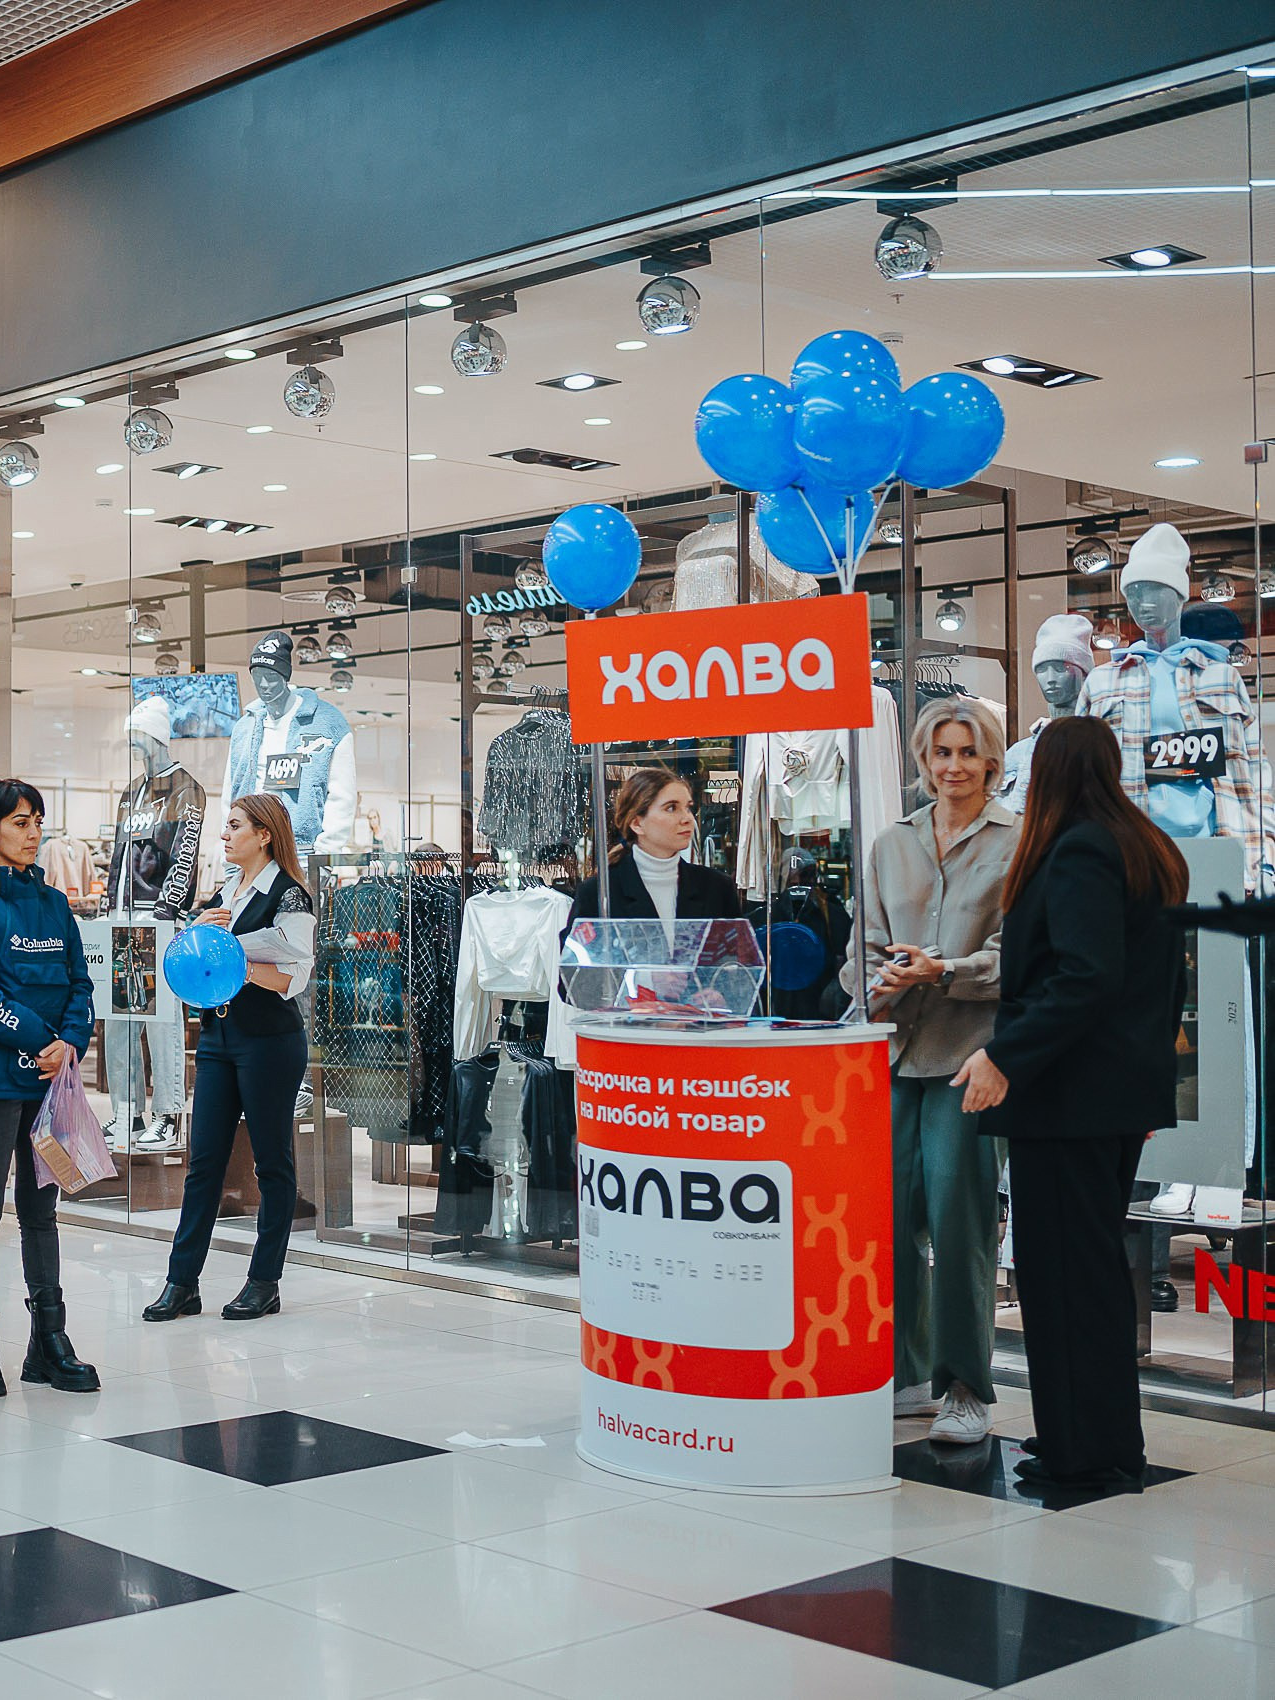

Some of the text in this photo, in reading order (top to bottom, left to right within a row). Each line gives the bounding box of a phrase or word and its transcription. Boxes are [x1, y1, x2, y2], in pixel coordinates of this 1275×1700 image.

[1151, 734, 1218, 768] 2999
[267, 757, 299, 780] 4699
[124, 812, 155, 833] 6999
[22, 937, 64, 949] Columbia
[657, 1077, 675, 1096] и
[682, 1074, 791, 1098] кэшбэк
[580, 1100, 767, 1139] на любой товар
[712, 1230, 781, 1241] СОВКОМБАНК
[597, 1406, 734, 1453] halvacard.ru
